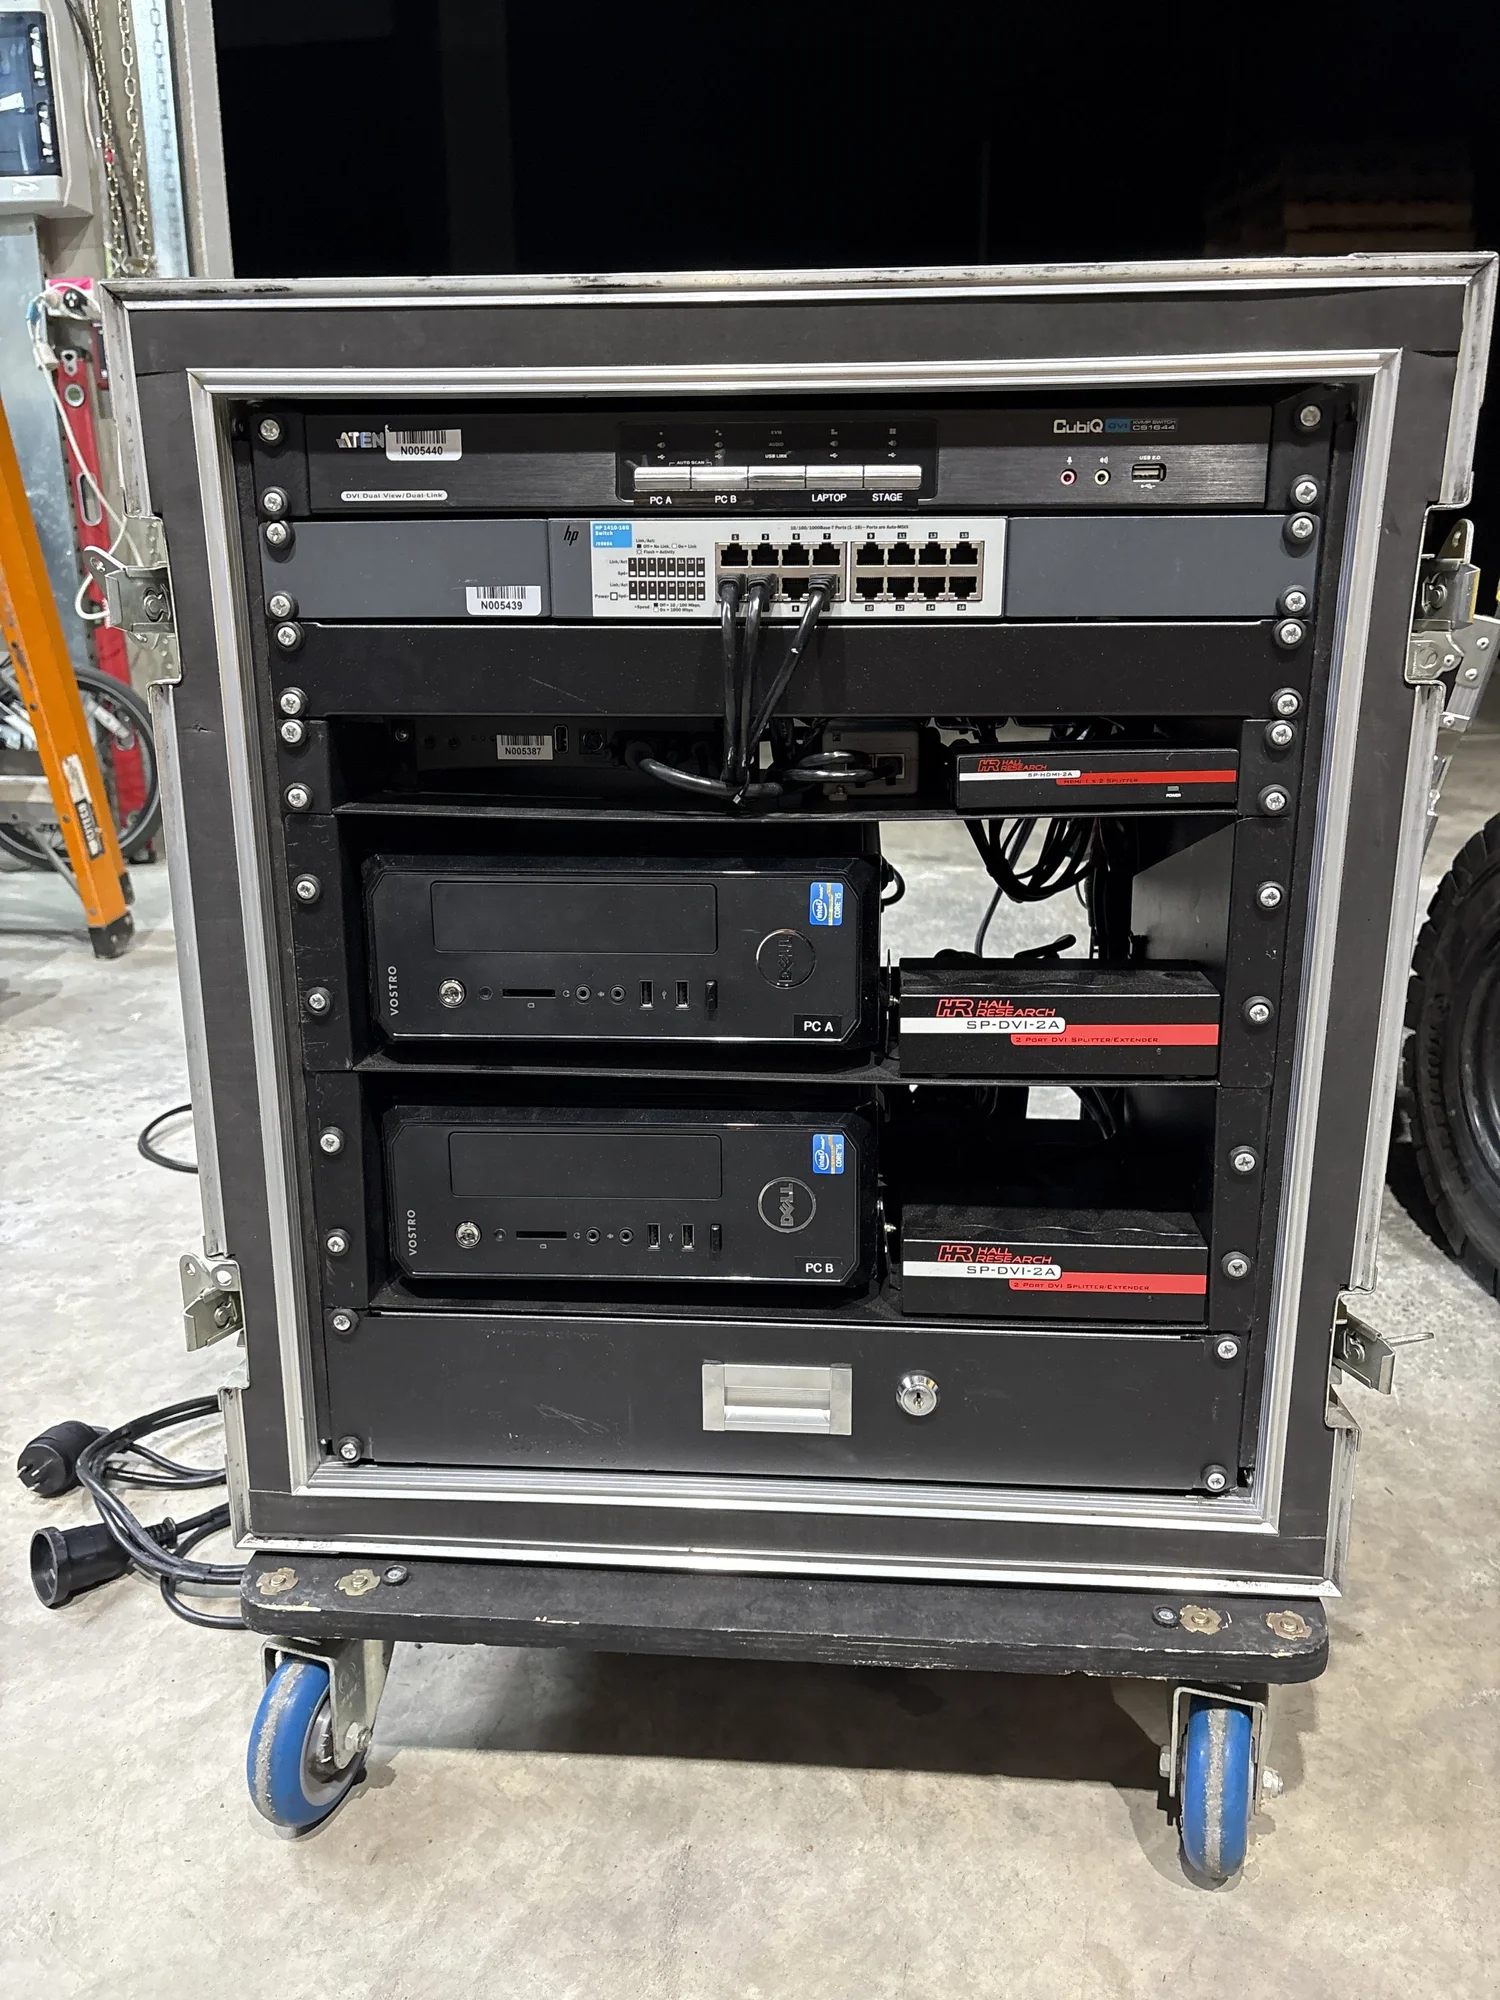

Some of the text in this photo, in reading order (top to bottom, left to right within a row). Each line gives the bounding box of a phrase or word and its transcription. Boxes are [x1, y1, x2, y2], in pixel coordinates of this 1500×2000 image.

[1053, 418, 1104, 433] CubiQ
[336, 431, 385, 448] ATEN
[400, 446, 443, 456] N005440
[649, 496, 672, 504] PC A
[714, 495, 737, 503] PC B
[812, 493, 847, 502] LAPTOP
[872, 493, 903, 502] STAGE
[563, 525, 579, 546] hp
[481, 601, 523, 610] N005439
[505, 747, 542, 756] N005387
[388, 966, 399, 1016] VOSTRO
[977, 1000, 1014, 1008] HALL
[975, 1008, 1056, 1017] RESEARCH
[803, 1021, 834, 1032] PC A
[966, 1020, 1060, 1030] SP-DVI-2A
[779, 1183, 794, 1227] DELL
[406, 1209, 418, 1256] VOSTRO
[977, 1246, 1012, 1256] HALL
[975, 1254, 1053, 1264] RESEARCH
[805, 1263, 834, 1273] PC B
[966, 1265, 1056, 1277] SP-DVI-2A
